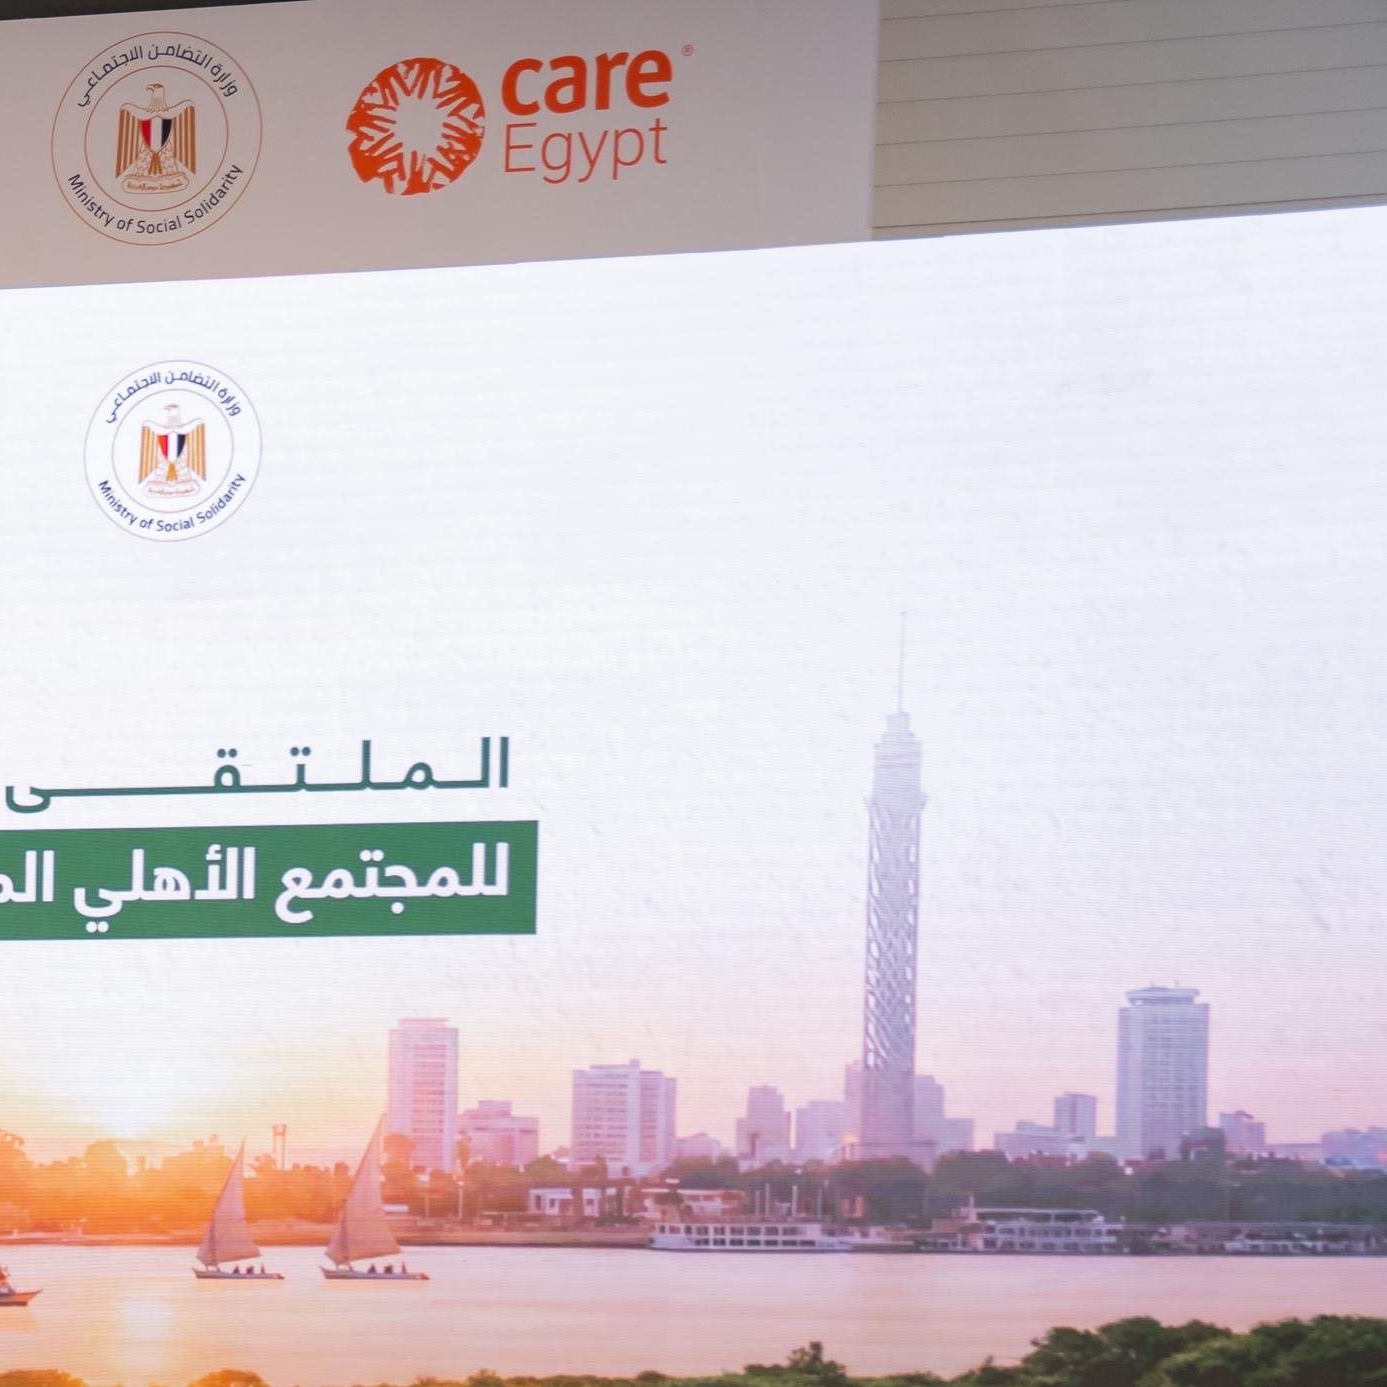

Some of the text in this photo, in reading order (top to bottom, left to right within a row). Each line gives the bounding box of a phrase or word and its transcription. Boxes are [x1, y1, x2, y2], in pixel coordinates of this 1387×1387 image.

[78, 43, 239, 107] وزارة التضامن الاجتماعي
[501, 49, 672, 116] care
[504, 117, 668, 184] Egypt
[67, 164, 244, 234] Ministry of Social Solidarity
[217, 387, 242, 417] وزارة
[98, 473, 247, 533] Ministry of Social Solidarity
[5, 736, 510, 814] الملتقى
[73, 844, 256, 934] الأهلي
[274, 842, 510, 924] للمجتمع
